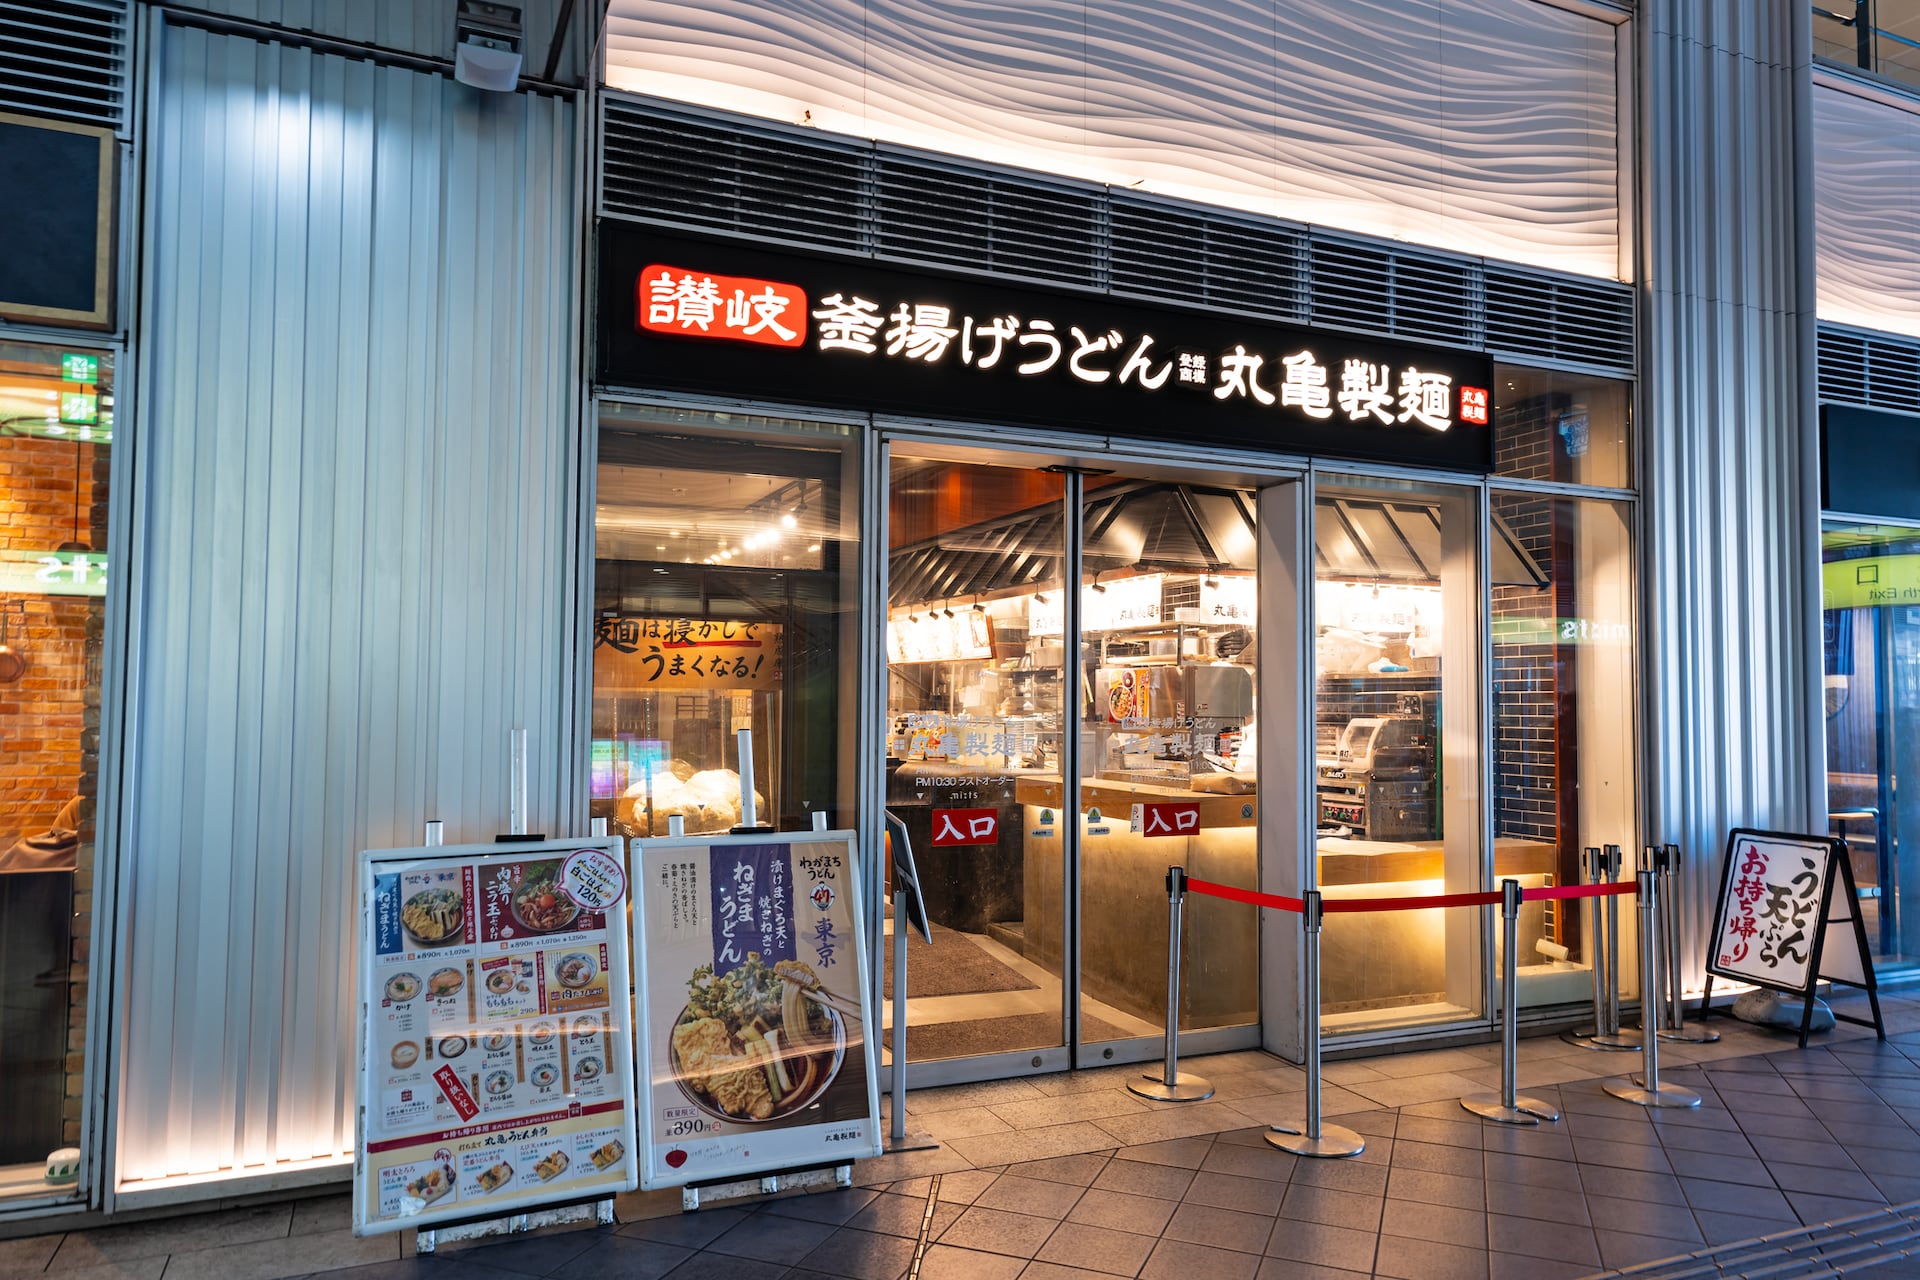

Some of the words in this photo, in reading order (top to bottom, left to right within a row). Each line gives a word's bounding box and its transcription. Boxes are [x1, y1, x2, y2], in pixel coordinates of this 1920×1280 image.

[812, 293, 1173, 390] 釜揚げうどん
[1214, 344, 1453, 432] 丸亀製麺
[642, 645, 764, 681] うまくなる!
[959, 775, 1015, 786] ラストオーダー
[935, 814, 996, 841] 入口
[1146, 805, 1199, 834] 入口
[497, 867, 512, 905] 肉盛り
[799, 856, 841, 869] わがまち
[807, 868, 835, 880] うどん
[576, 884, 603, 907] 120円
[733, 861, 754, 922] ねぎま
[771, 859, 788, 949] 漬けまぐろ天と
[1729, 845, 1770, 962] お持ち帰り
[1777, 857, 1819, 964] うどん
[719, 896, 742, 963] うどん
[758, 895, 772, 956] 焼きねぎの
[814, 917, 838, 968] 東京
[1759, 882, 1792, 968] 天ぷら
